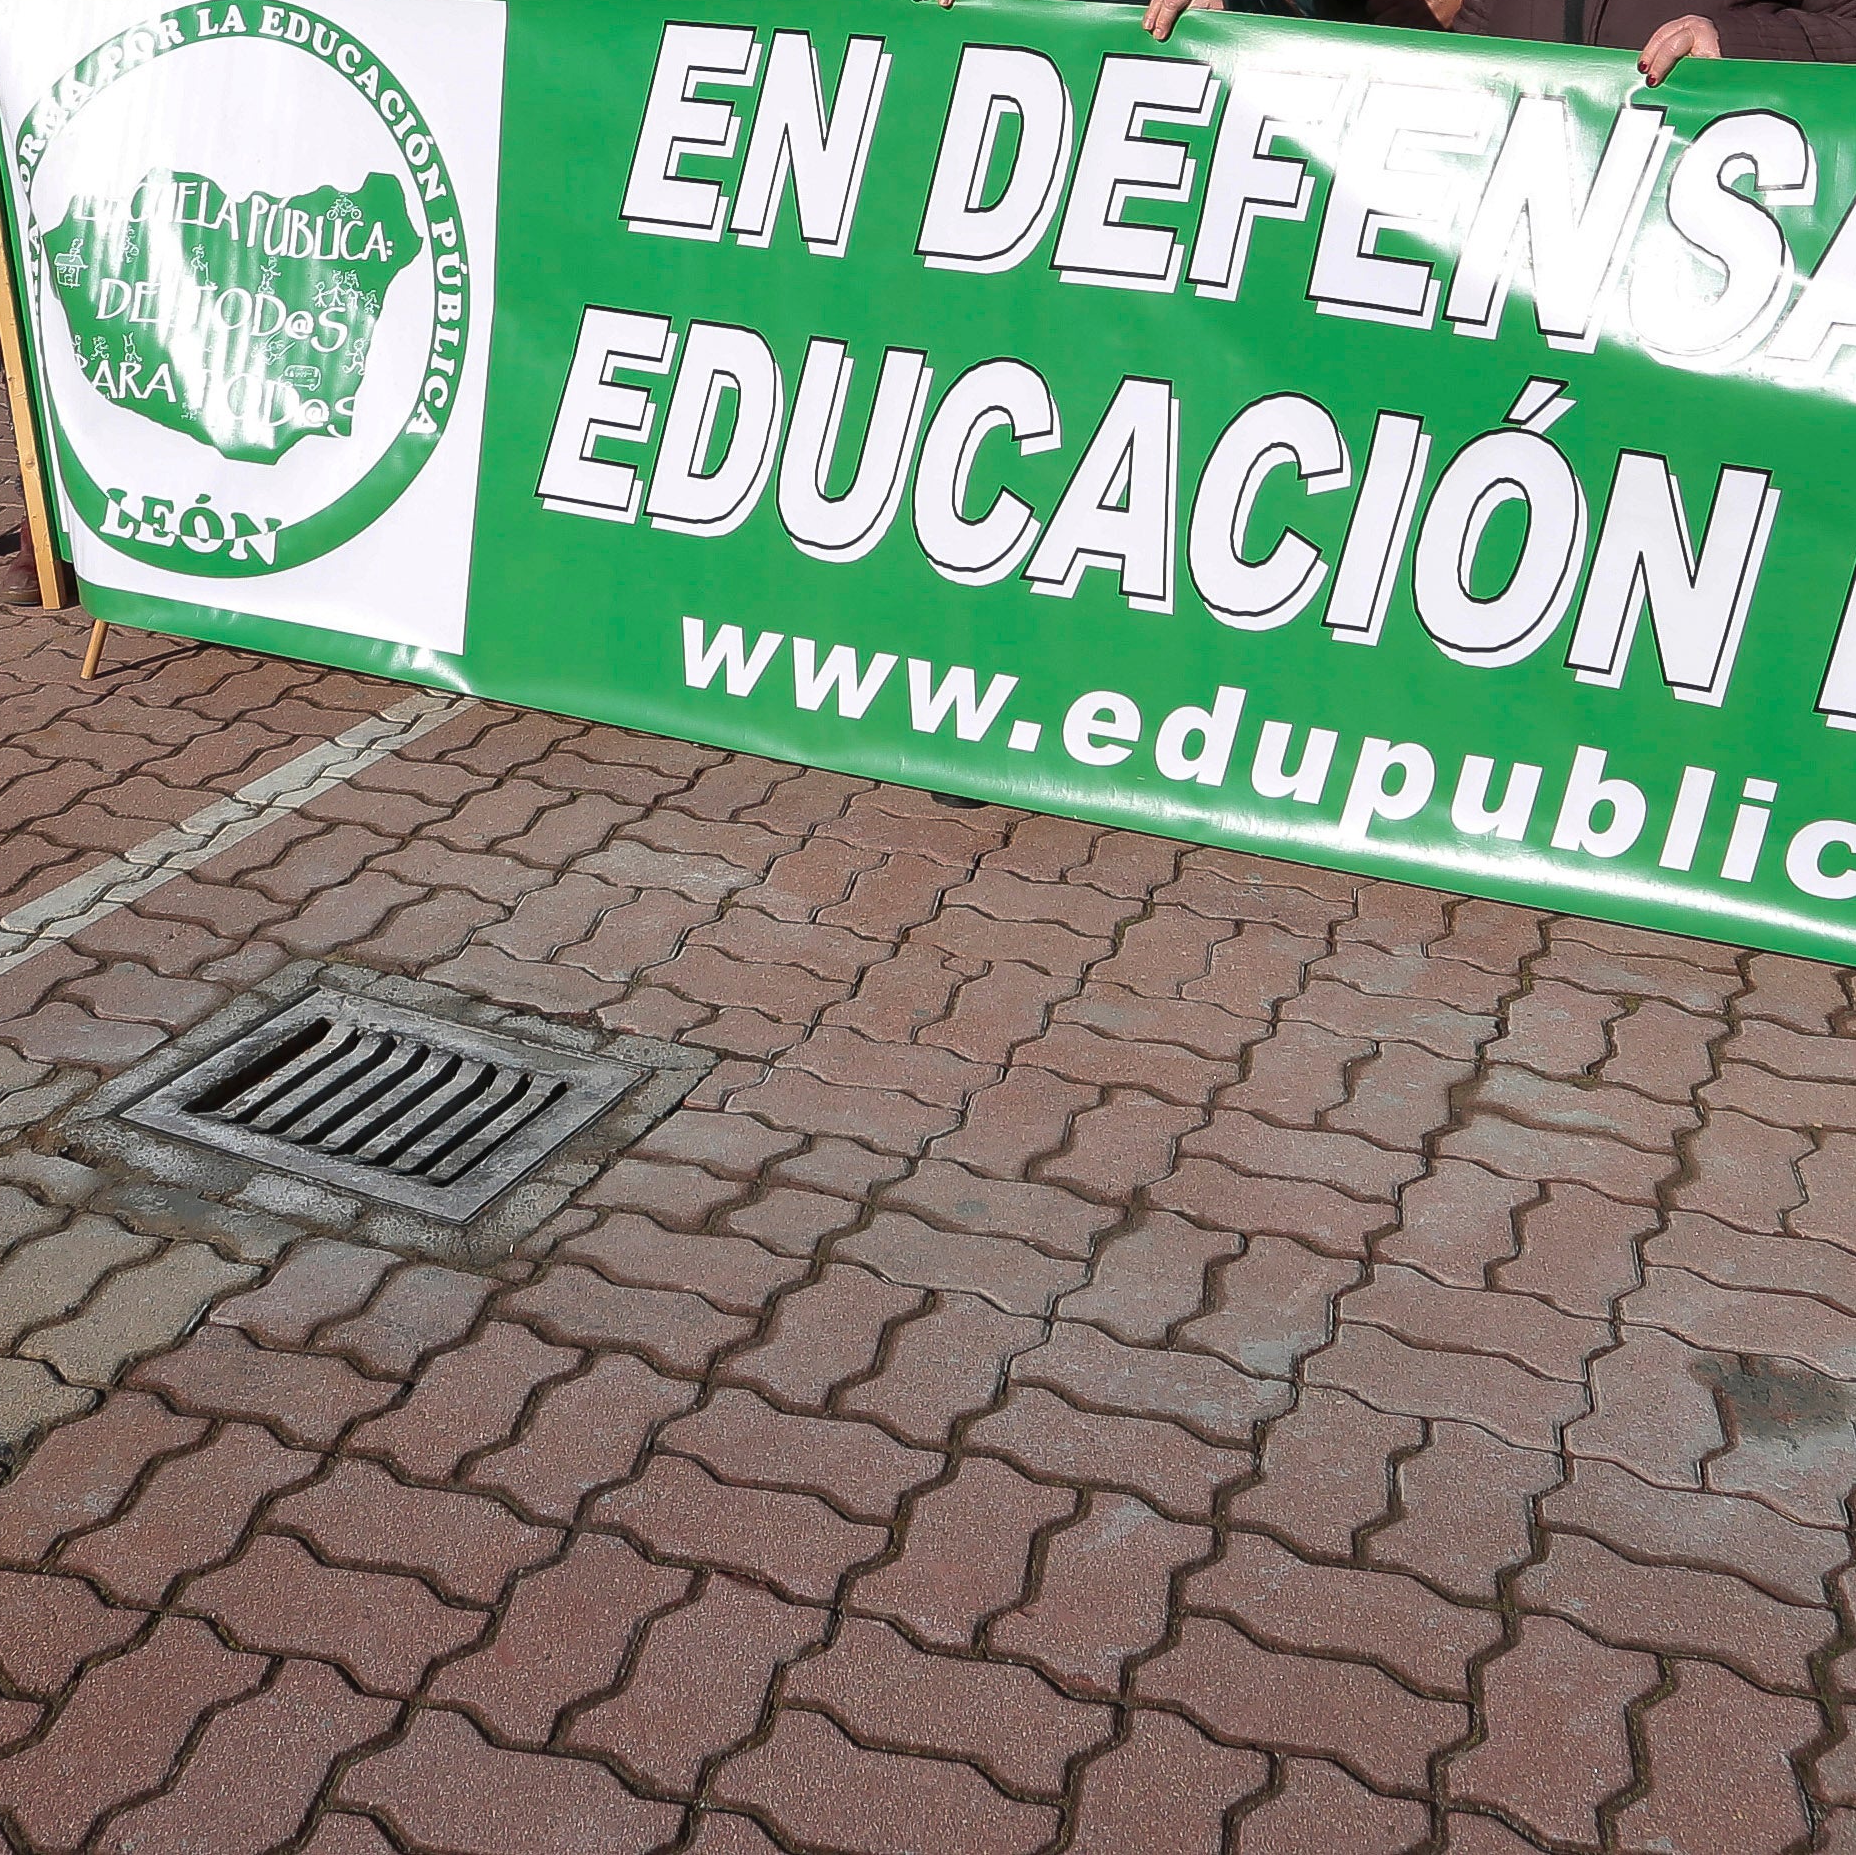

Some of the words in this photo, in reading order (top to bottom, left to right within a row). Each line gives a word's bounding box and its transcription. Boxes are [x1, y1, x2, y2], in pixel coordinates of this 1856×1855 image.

[619, 19, 893, 259] EN
[73, 181, 240, 242] ECELA
[246, 193, 394, 262] PÚBLICA:
[196, 3, 247, 37] LA
[257, 3, 447, 202] EDUCACIÓN
[406, 217, 469, 436] PÚBLICA
[96, 277, 162, 324] DE
[201, 367, 356, 437] OD@S
[98, 487, 283, 566] LEÓN
[535, 303, 1781, 708] EDUCACIÓN
